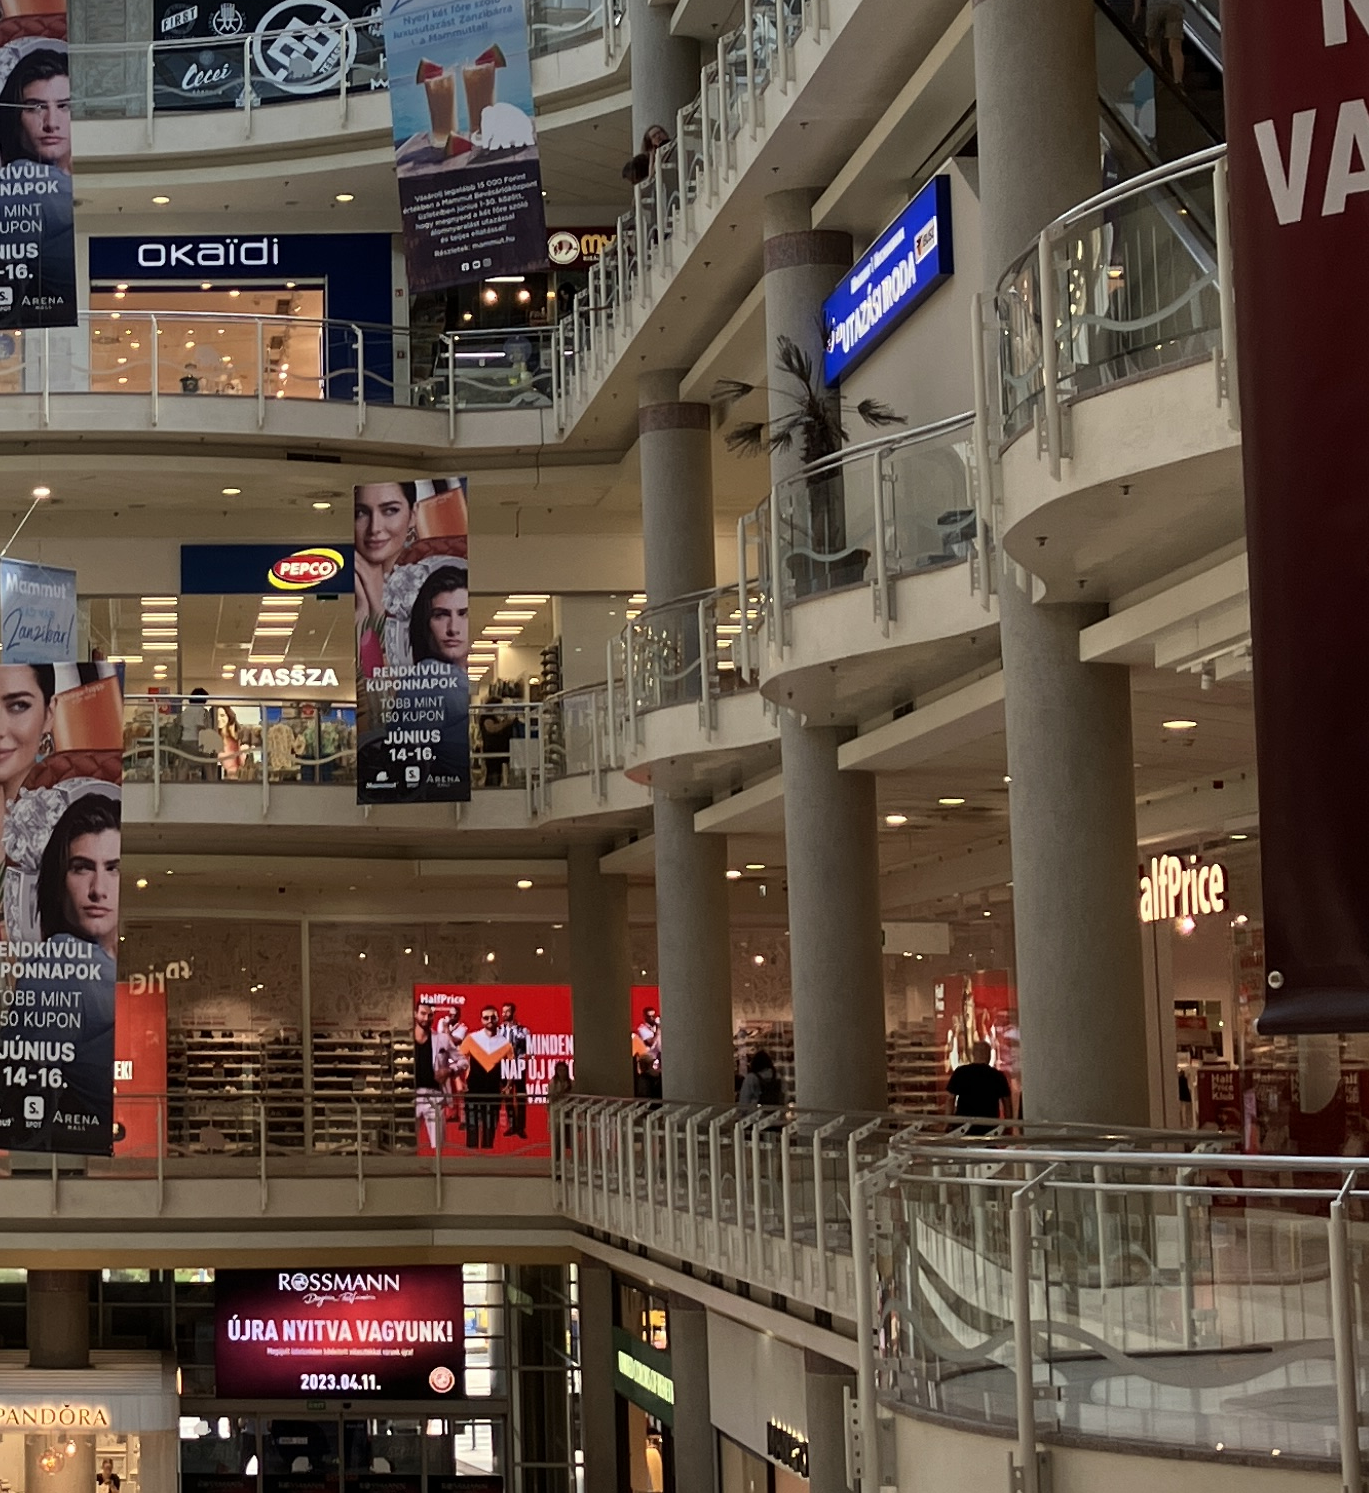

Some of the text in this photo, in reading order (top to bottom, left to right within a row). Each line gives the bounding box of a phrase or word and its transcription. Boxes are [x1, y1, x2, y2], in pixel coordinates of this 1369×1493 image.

[162, 6, 198, 33] FIRST
[183, 63, 232, 90] Cecei
[5, 203, 42, 218] MINT
[138, 237, 278, 267] okaïdi
[21, 295, 64, 306] ARENA
[280, 561, 332, 576] PEPCO
[6, 572, 66, 599] Mammut
[3, 607, 75, 655] Zanzibár!
[240, 668, 339, 687] KASSZA
[373, 663, 451, 678] RENDKÍVÜLI
[366, 677, 458, 692] KUPONNAPOK
[380, 695, 445, 710] TÖBB MINT
[380, 710, 445, 723] 150 KUPON
[384, 727, 441, 745] JÚNIUS
[389, 748, 437, 762] 14-16.
[426, 774, 461, 783] ARENA
[1139, 854, 1224, 923] alfPrice
[40, 991, 82, 1008] MINT
[420, 993, 466, 1005] HalfPrice
[23, 1011, 82, 1029] KUPON
[525, 1034, 574, 1056] MINDEN
[501, 1058, 526, 1080] NAP
[528, 1056, 545, 1080] ÚJ
[2, 1066, 68, 1089] 14-16.
[52, 1111, 100, 1126] ARENA
[278, 1273, 400, 1292] ROSSMANN
[228, 1314, 453, 1343] ÚJRA NYITVA VAGYUNK!
[300, 1374, 382, 1391] 2023.04.11.
